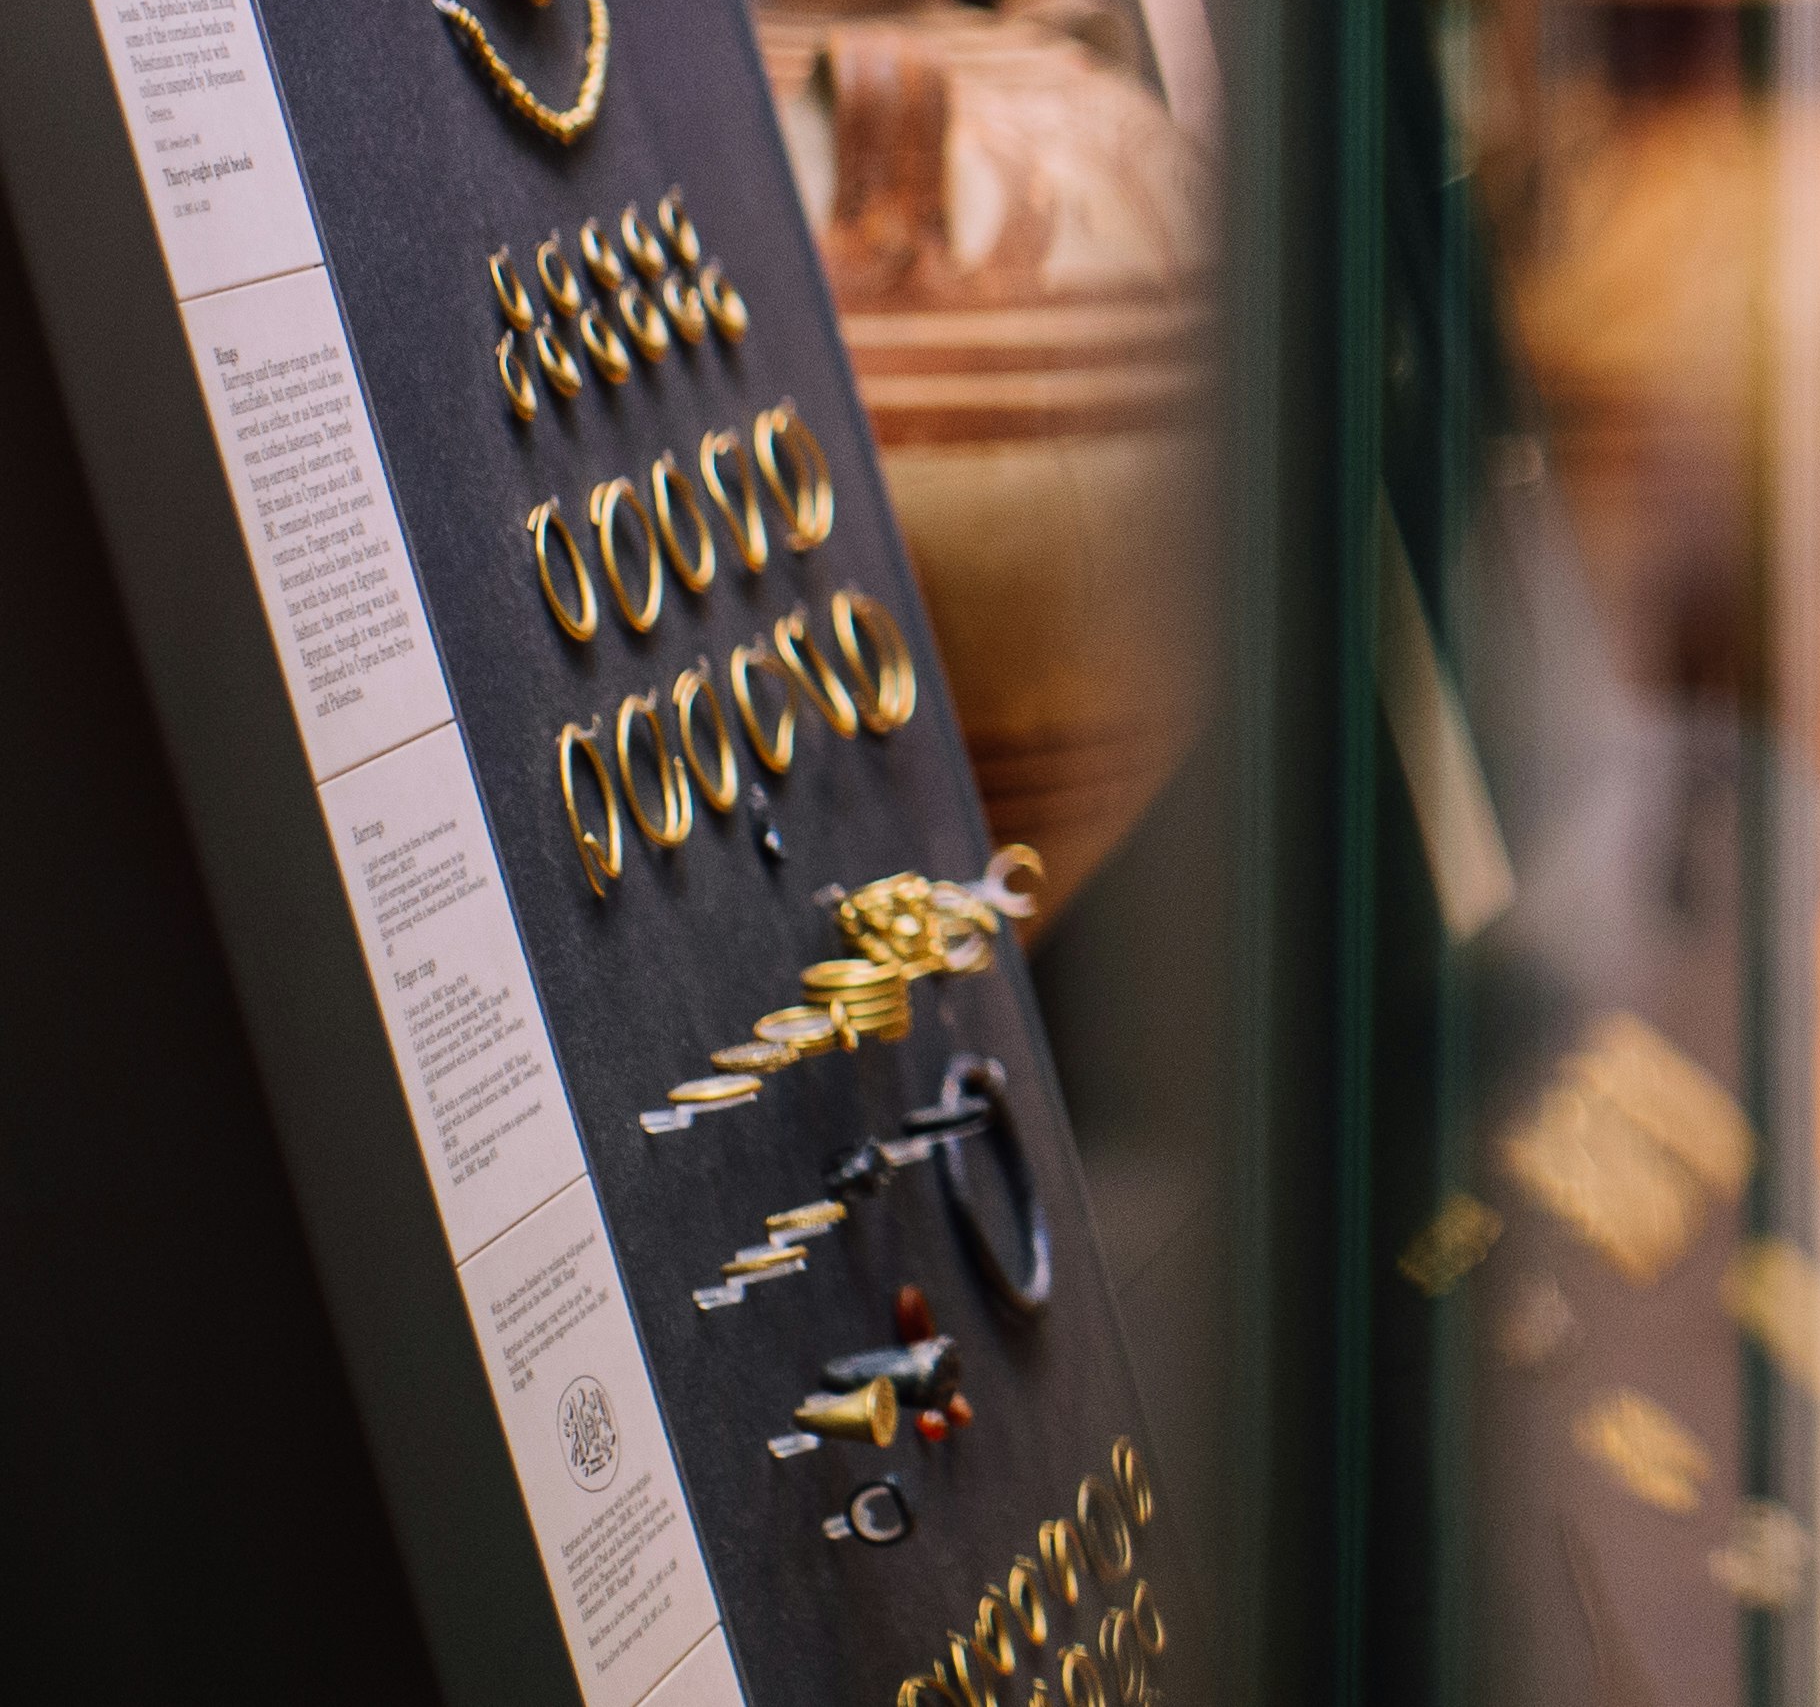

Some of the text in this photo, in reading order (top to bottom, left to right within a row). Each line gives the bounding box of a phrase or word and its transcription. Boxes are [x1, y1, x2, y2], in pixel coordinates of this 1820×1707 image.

[139, 0, 157, 19] The
[125, 17, 235, 47] some of the cornelian beads are
[173, 53, 184, 66] in
[182, 51, 199, 68] type
[197, 45, 213, 62] but
[212, 41, 230, 59] with
[165, 72, 196, 96] inspired
[193, 71, 205, 92] by
[162, 152, 253, 186] Thirty-eight gold beads
[213, 347, 238, 366] Rings
[220, 371, 254, 391] Earrings
[254, 361, 269, 381] and
[308, 351, 320, 366] are
[269, 386, 285, 403] but
[307, 370, 328, 392] could
[325, 369, 343, 386] have
[236, 418, 260, 441] served
[260, 420, 269, 434] as
[292, 410, 301, 424] or
[300, 407, 310, 421] as
[342, 394, 351, 407] or
[243, 450, 261, 466] even
[260, 439, 287, 460] clothes
[321, 416, 351, 441] Tapered
[269, 465, 299, 485] earrings
[298, 456, 307, 475] of
[273, 489, 293, 511] made
[292, 490, 302, 504] in
[301, 482, 327, 503] Cyprus
[327, 473, 347, 492] about
[279, 509, 312, 536] remained
[311, 502, 338, 528] popular
[337, 496, 349, 515] for
[348, 517, 365, 537] with
[279, 563, 314, 591] decorated
[333, 553, 352, 570] have
[350, 546, 364, 564] the
[380, 539, 390, 552] in
[300, 589, 319, 610] with
[317, 586, 330, 604] the
[328, 582, 348, 599] hoop
[348, 578, 357, 592] in
[354, 567, 387, 591] Egyptian
[321, 612, 335, 630] the
[370, 595, 385, 608] was
[334, 627, 360, 652] though
[359, 627, 368, 642] it
[366, 624, 381, 637] was
[380, 608, 409, 638] probably
[308, 636, 414, 692] introduced to Cyprus from Syria
[315, 694, 330, 717] and
